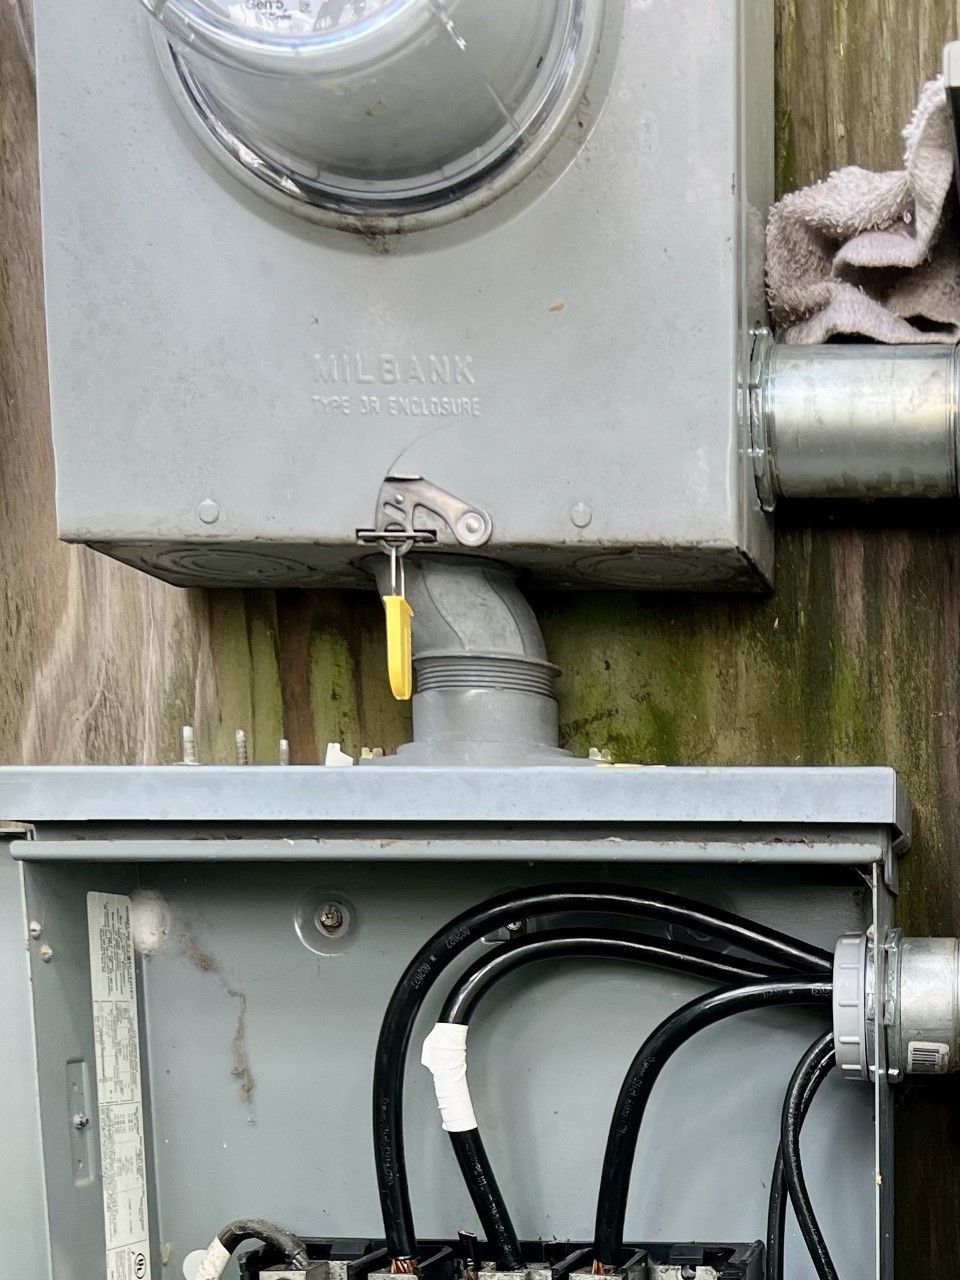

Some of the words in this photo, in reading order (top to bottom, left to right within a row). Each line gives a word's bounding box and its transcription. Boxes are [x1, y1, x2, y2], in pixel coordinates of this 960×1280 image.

[313, 352, 475, 384] MILBANK
[312, 395, 350, 415] TYPE
[360, 395, 380, 416] 3R
[388, 396, 481, 417] ENCLOSURE
